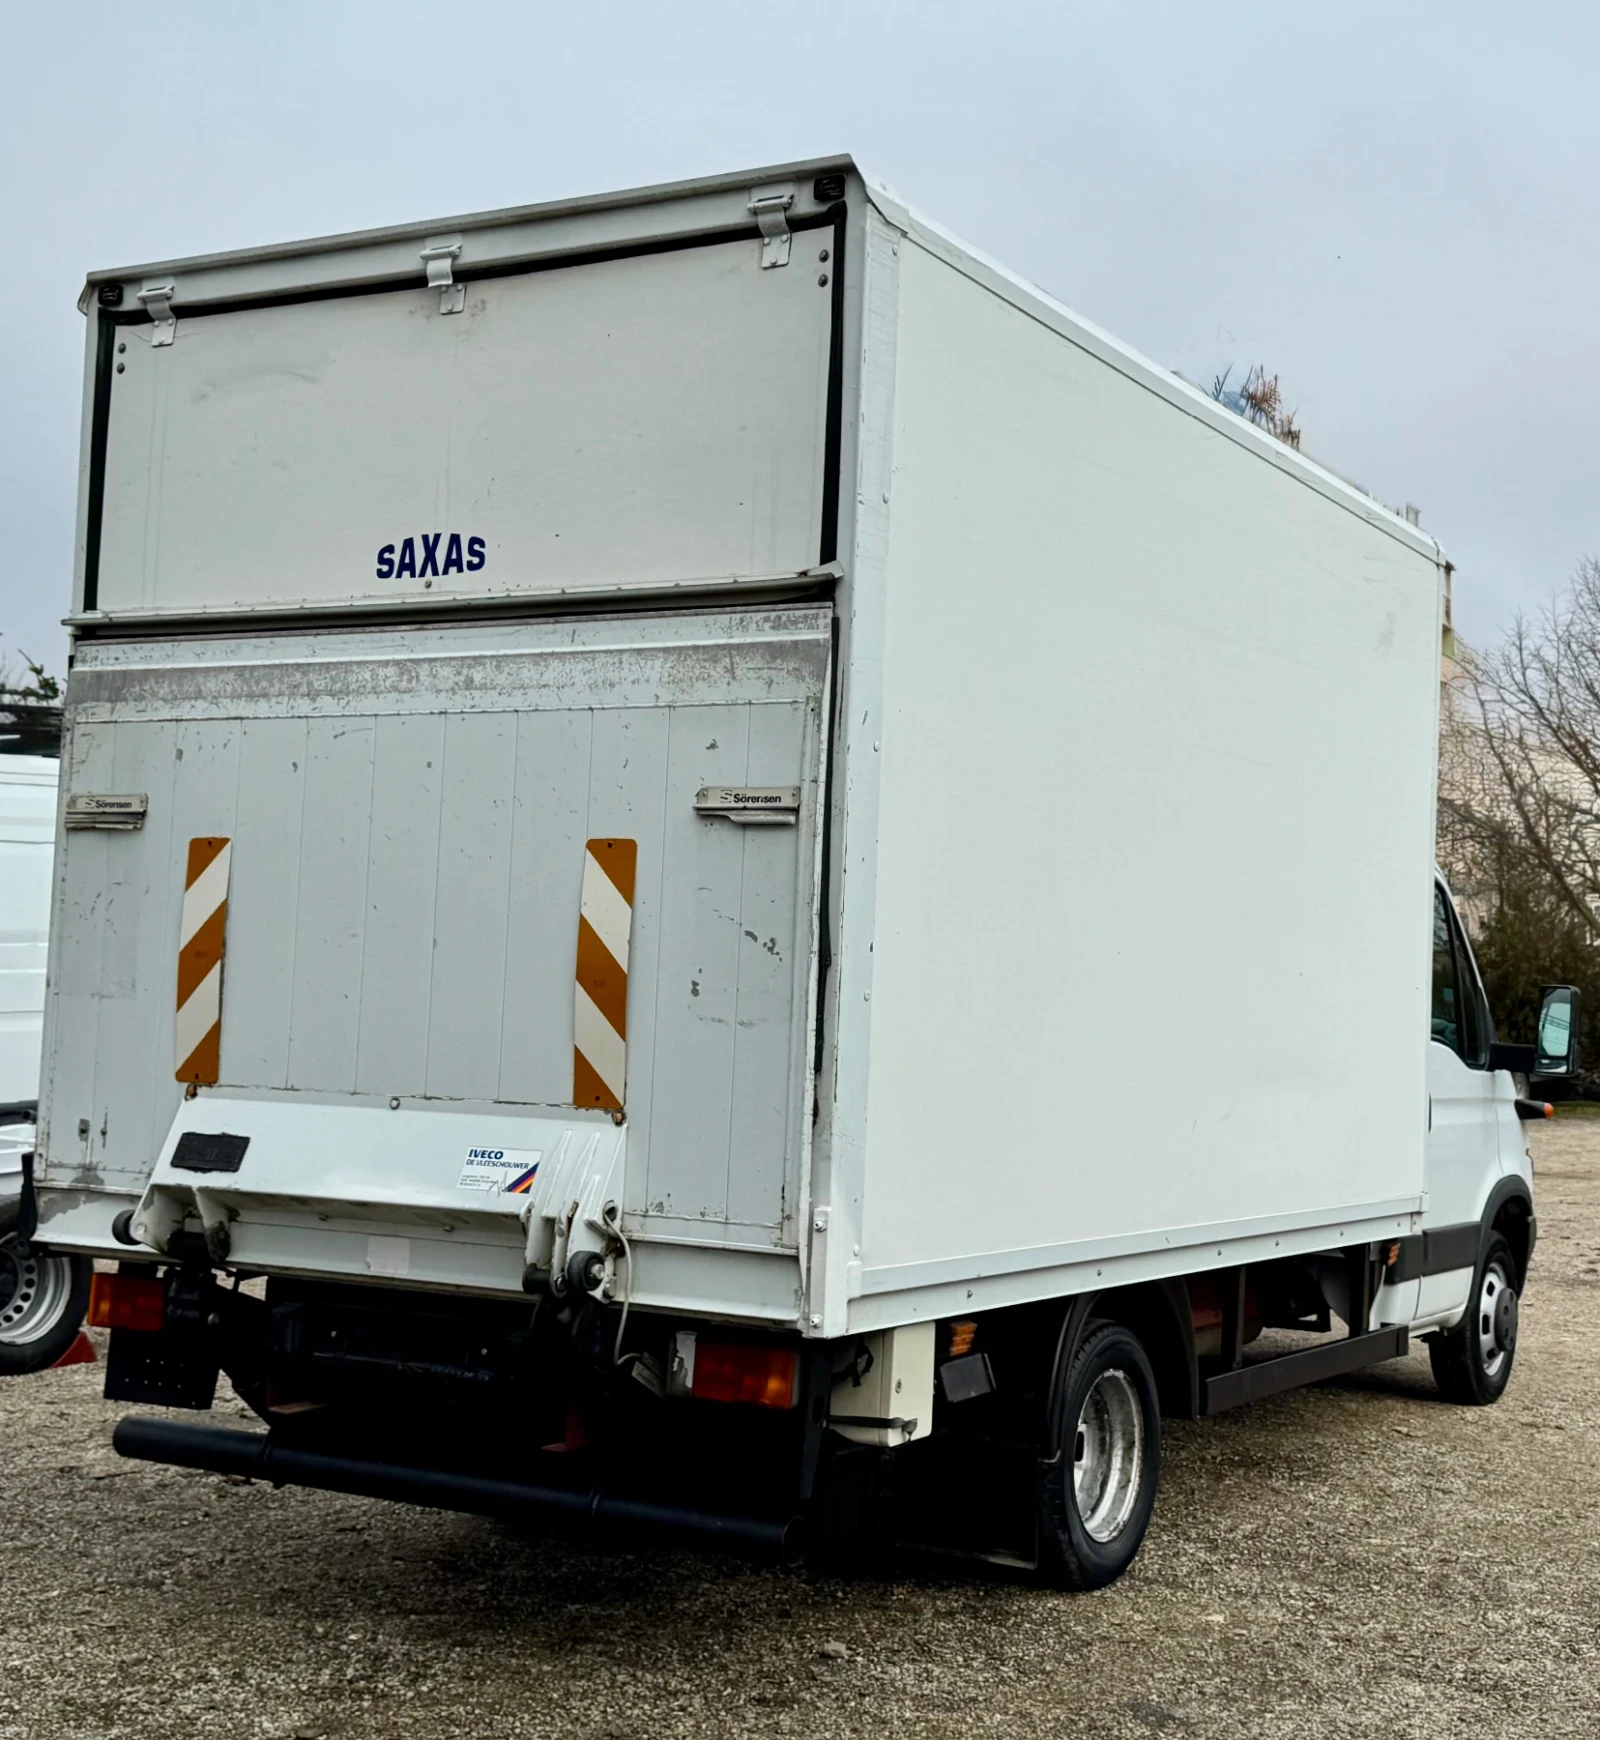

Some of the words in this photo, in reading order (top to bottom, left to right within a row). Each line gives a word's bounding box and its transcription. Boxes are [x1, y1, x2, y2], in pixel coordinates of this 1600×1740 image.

[376, 533, 486, 579] SAXAS
[95, 799, 133, 809] Sörensen
[733, 793, 782, 804] Sörensen
[468, 1149, 504, 1160] IVECO
[466, 1158, 474, 1166] DE
